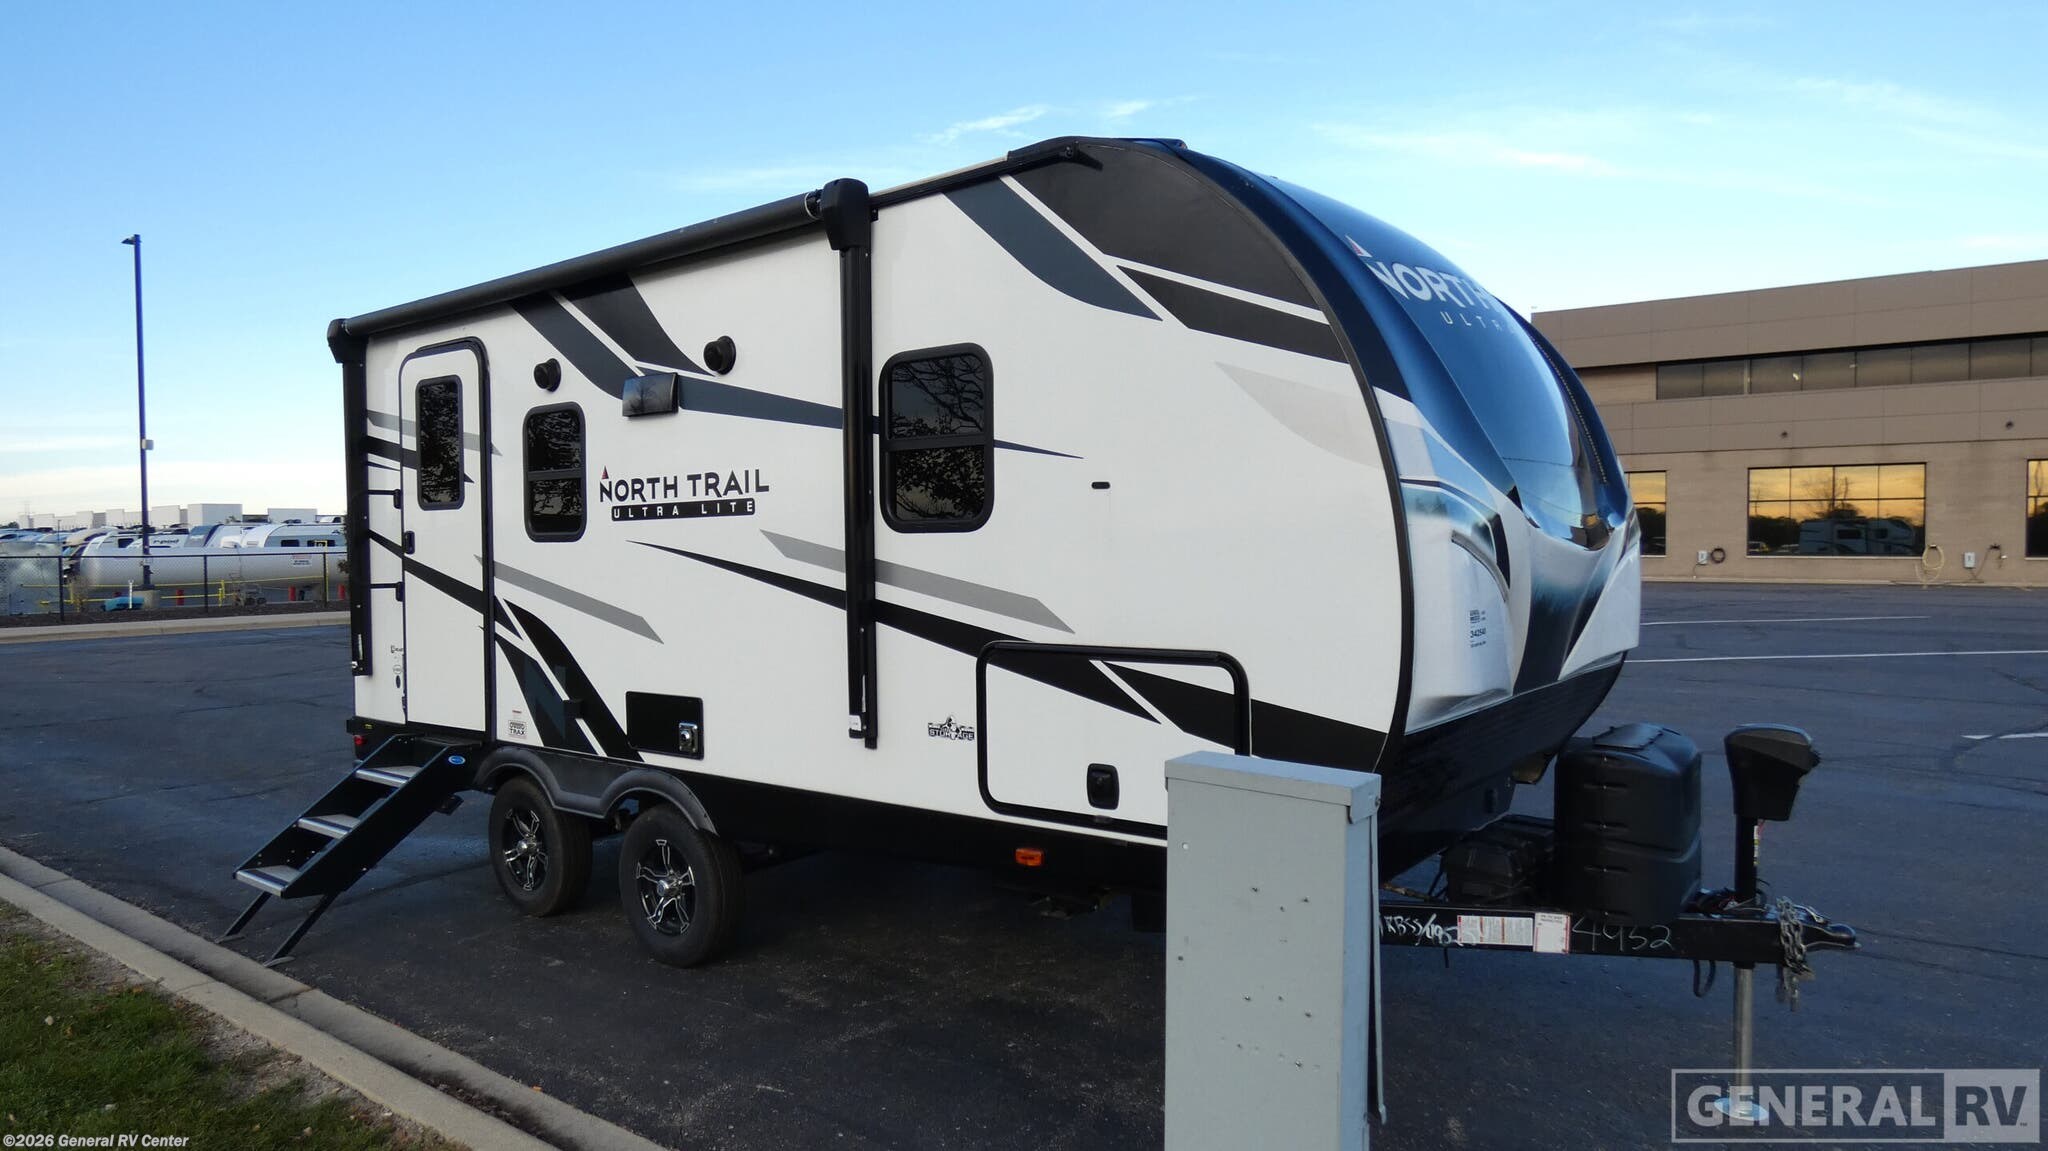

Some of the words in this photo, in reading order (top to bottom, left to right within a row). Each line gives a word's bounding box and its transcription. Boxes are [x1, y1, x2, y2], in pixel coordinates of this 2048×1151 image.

[1366, 261, 1499, 312] NORTH
[1440, 311, 1502, 332] ULTR
[600, 475, 678, 503] NORTH
[687, 469, 769, 498] TRAIL
[614, 505, 679, 518] ULTRA
[701, 501, 753, 514] LITE
